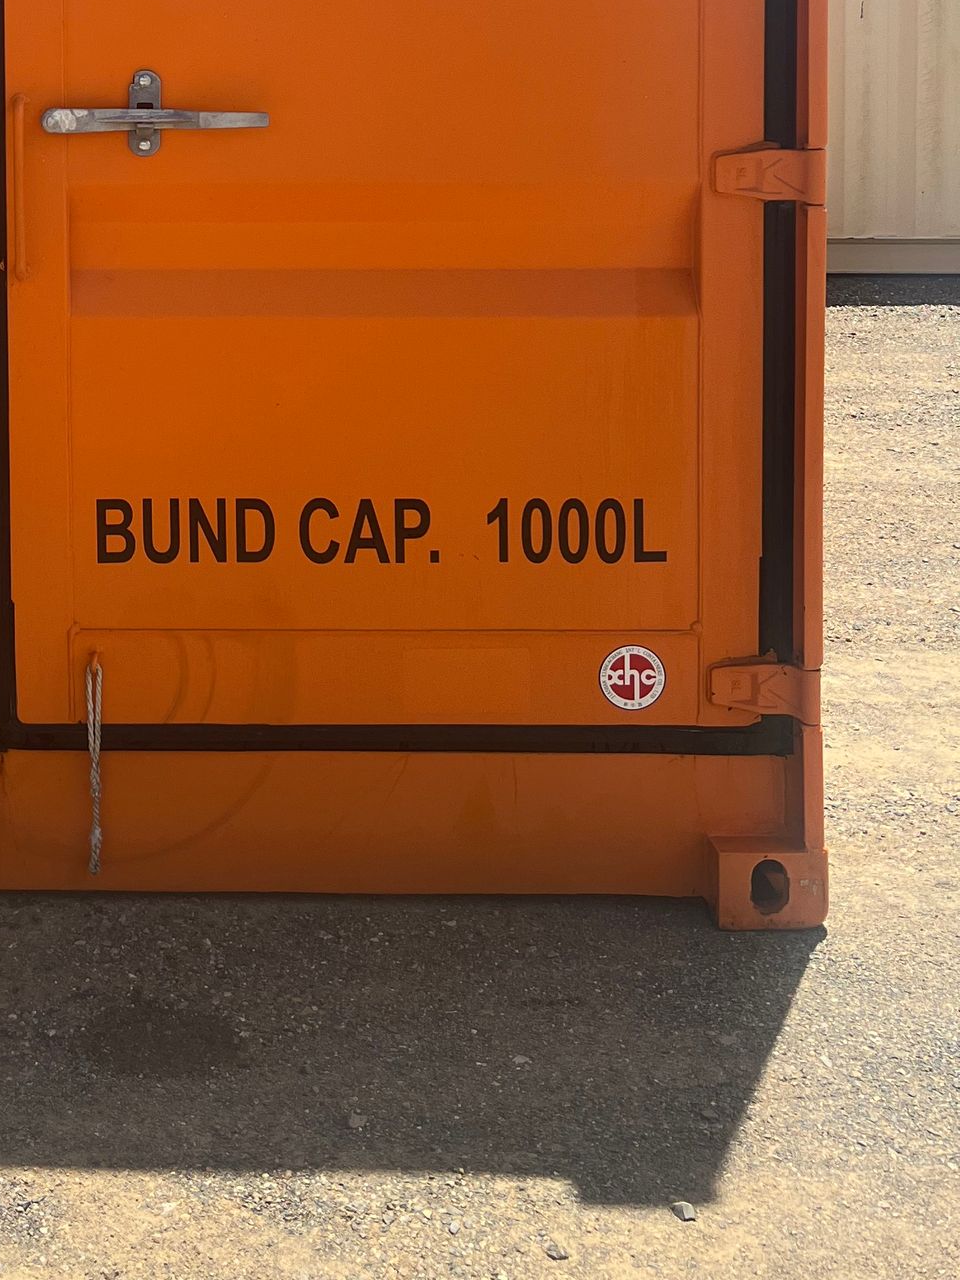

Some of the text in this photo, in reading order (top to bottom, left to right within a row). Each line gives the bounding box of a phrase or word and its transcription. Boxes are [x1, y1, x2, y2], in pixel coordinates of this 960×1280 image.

[96, 497, 667, 564] BUND CAP. 1000L
